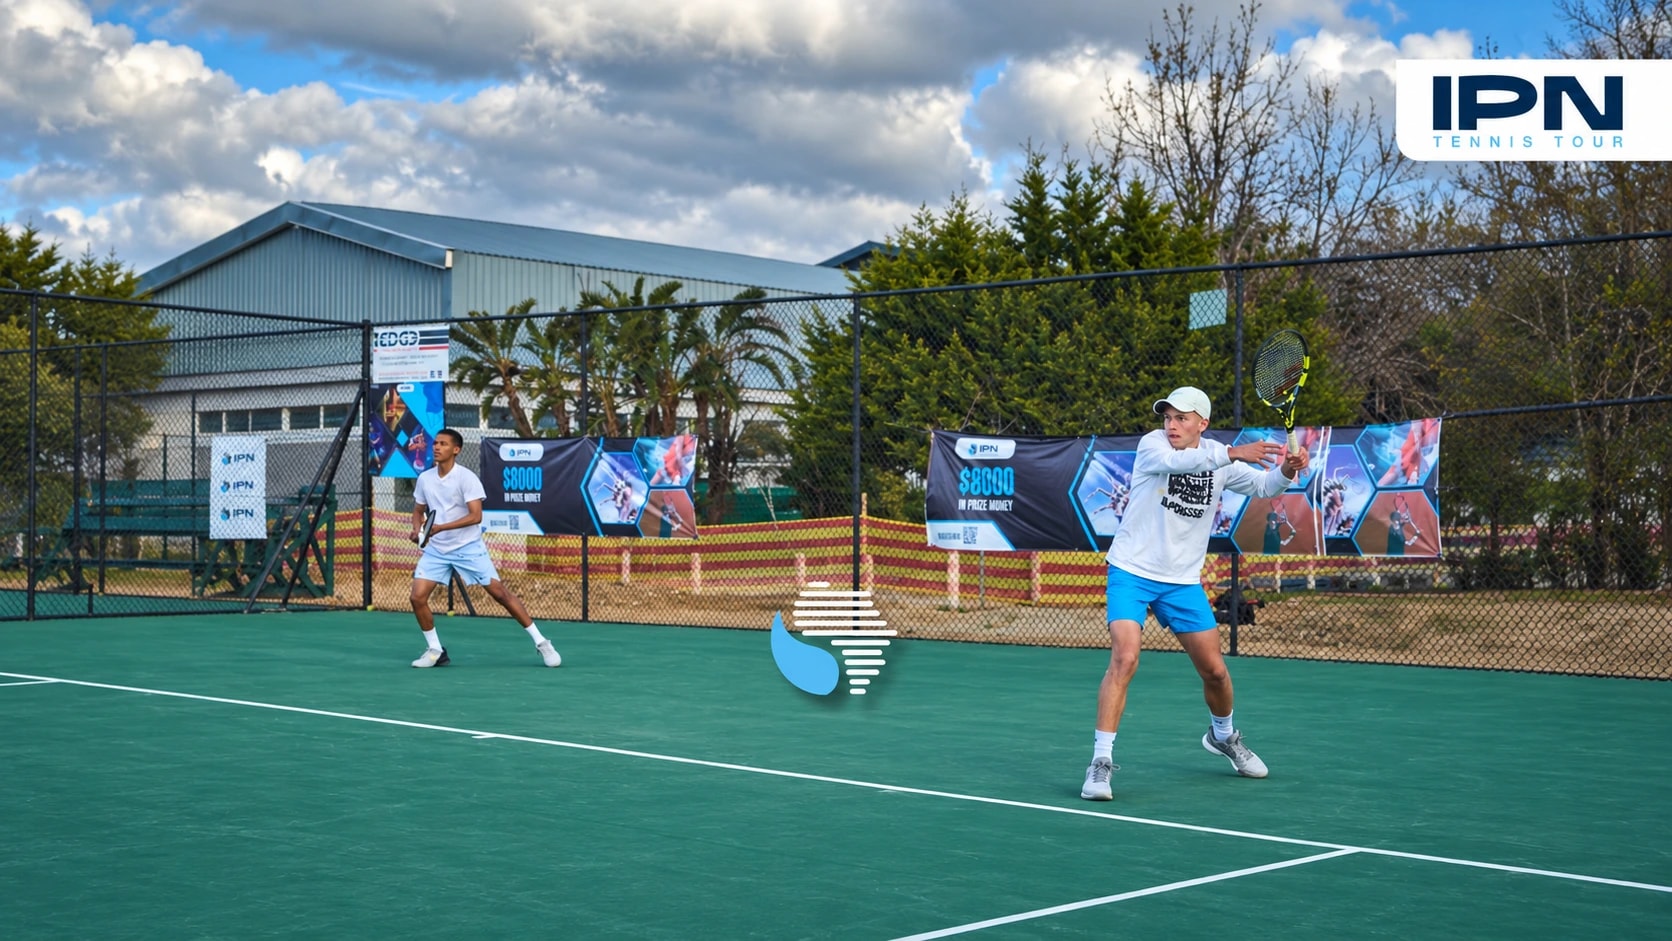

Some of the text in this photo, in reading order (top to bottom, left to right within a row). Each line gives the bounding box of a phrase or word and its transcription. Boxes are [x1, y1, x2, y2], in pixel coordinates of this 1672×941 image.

[517, 449, 531, 457] IPN
[979, 444, 999, 453] IPN
[233, 453, 255, 463] IPN
[503, 466, 543, 491] $8000
[958, 465, 1015, 497] $8000
[232, 481, 254, 490] IPN
[958, 499, 1013, 512] IN PRIZE MONEY
[232, 508, 254, 518] IPN
